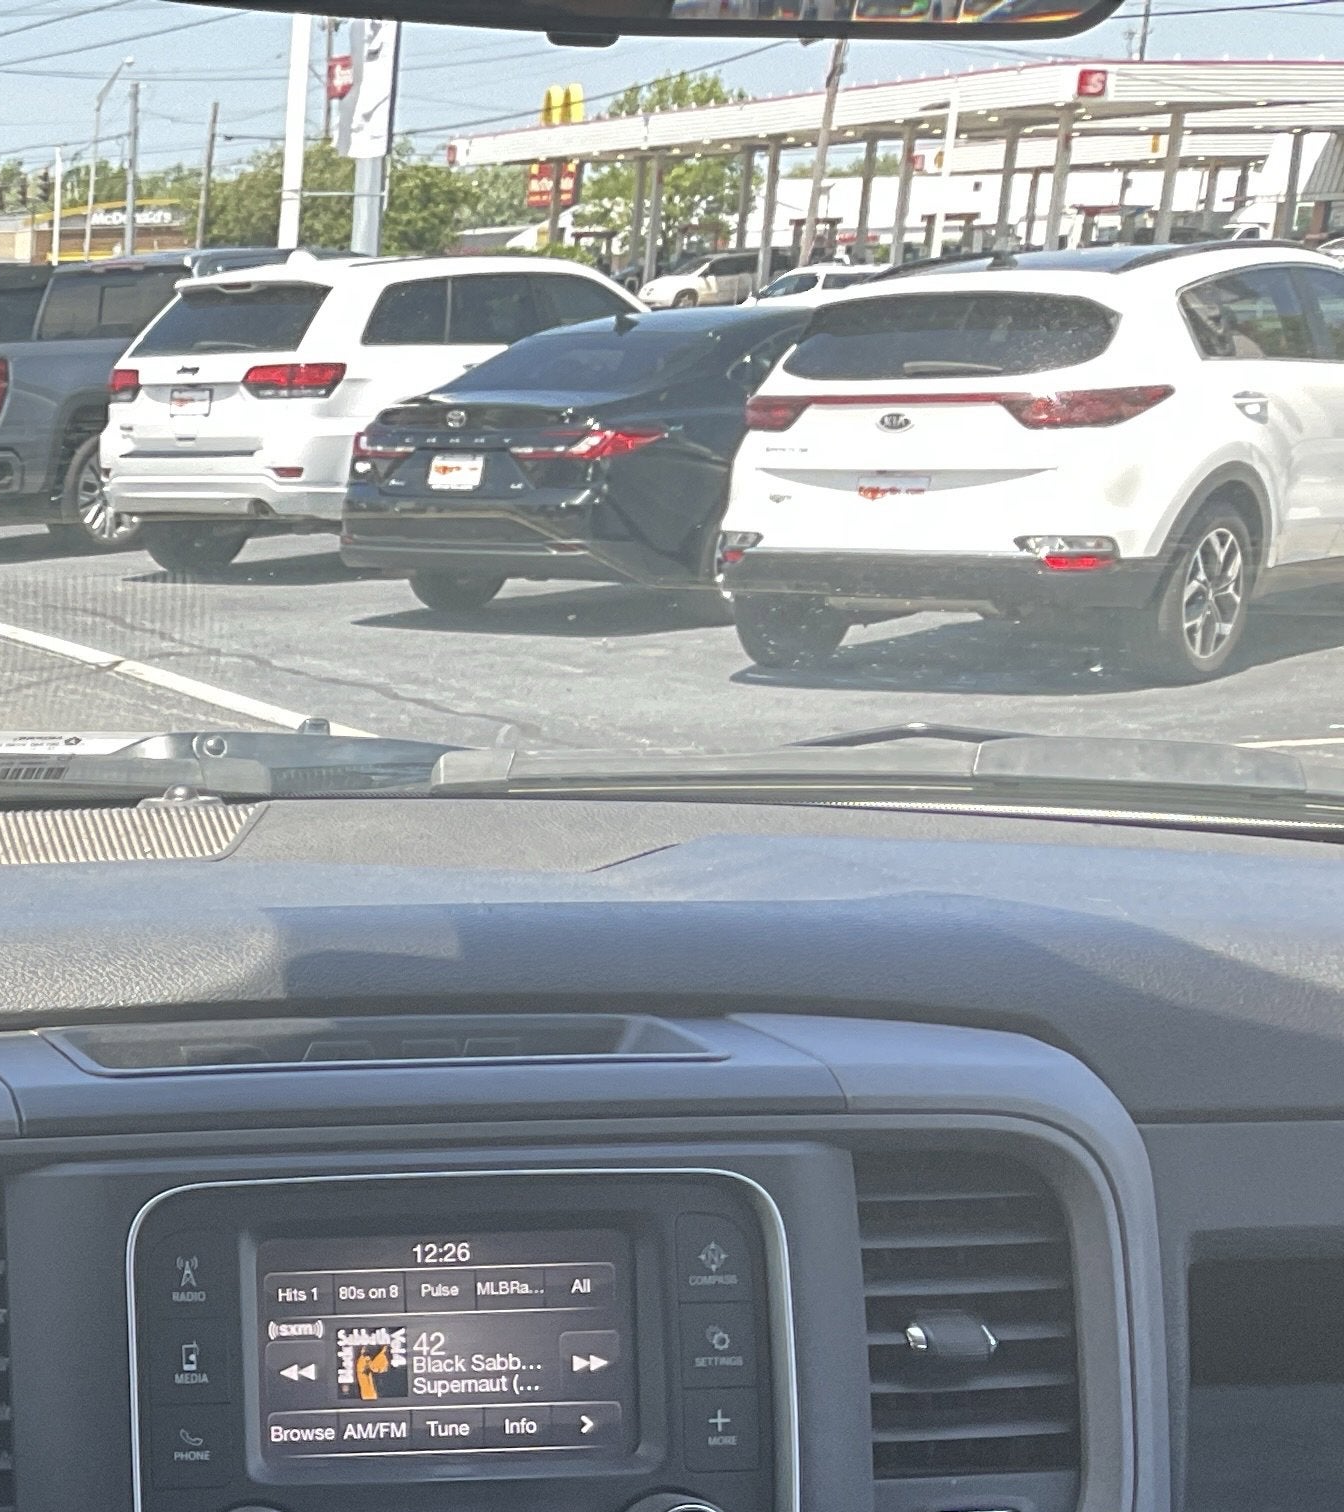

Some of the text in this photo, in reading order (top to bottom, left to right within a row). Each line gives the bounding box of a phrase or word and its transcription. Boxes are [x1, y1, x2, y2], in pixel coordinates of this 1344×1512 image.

[882, 414, 909, 428] KIA
[412, 1243, 471, 1263] 12:26
[278, 1286, 319, 1303] Hits 1
[338, 1285, 399, 1301] 80s on 8
[420, 1282, 459, 1297] Pulse
[571, 1278, 592, 1294] All
[172, 1291, 206, 1302] RADIO
[413, 1332, 446, 1355] 42
[413, 1354, 466, 1372] Black
[175, 1373, 209, 1384] MEDIA
[413, 1375, 508, 1397] Supernaut
[270, 1426, 335, 1443] Browse
[343, 1422, 407, 1441] AM/FM
[427, 1420, 470, 1438] Tune
[504, 1418, 537, 1435] Info
[708, 1435, 737, 1446] MORE
[174, 1451, 210, 1461] PHONE
